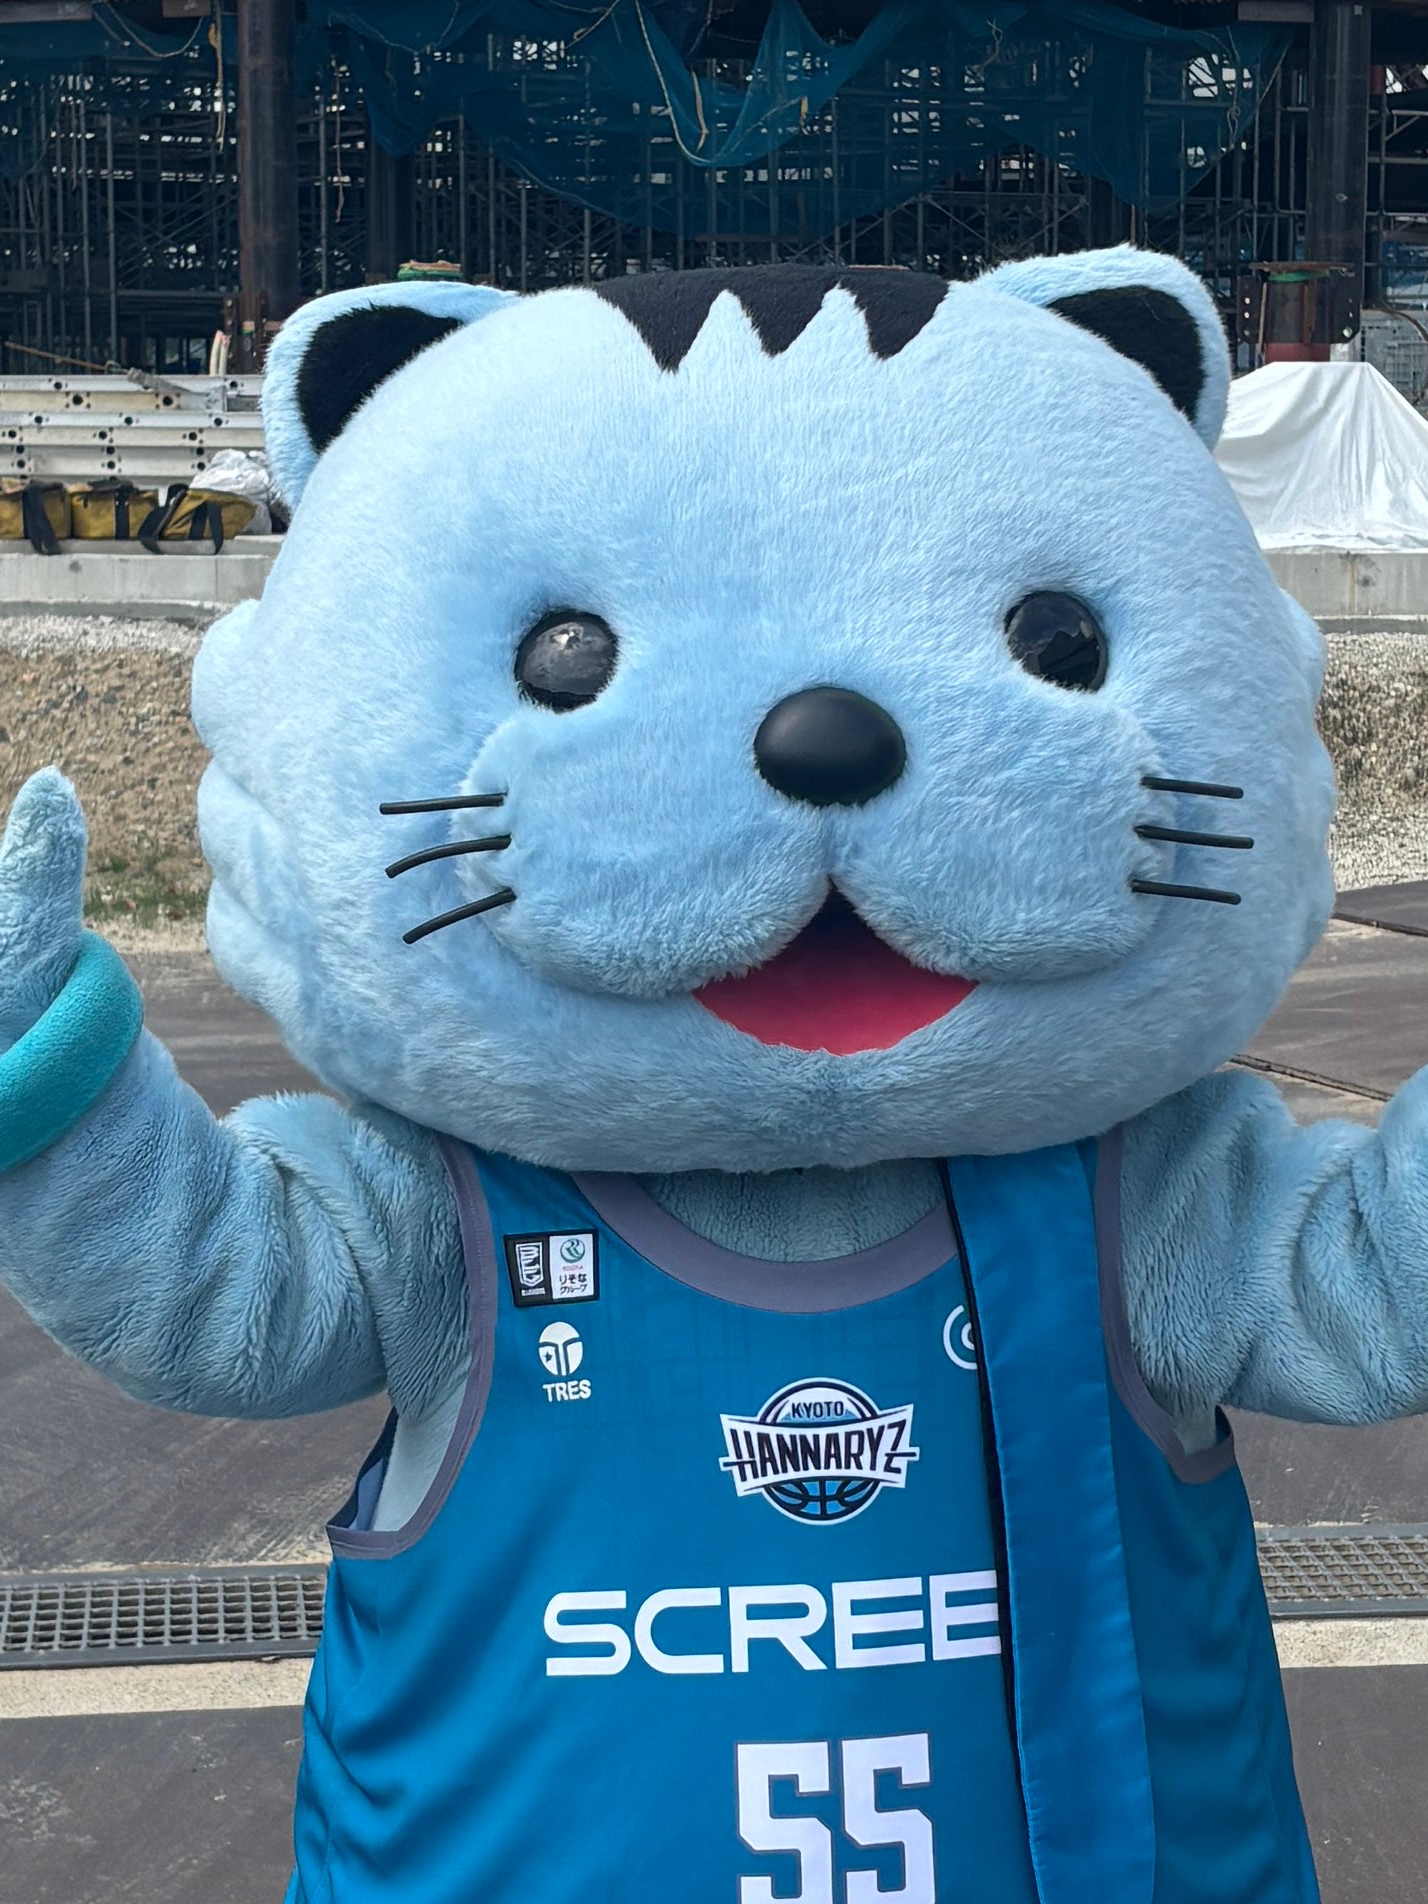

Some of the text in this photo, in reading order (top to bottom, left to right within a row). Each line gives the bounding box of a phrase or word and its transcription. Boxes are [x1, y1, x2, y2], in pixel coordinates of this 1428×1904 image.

[542, 1379, 592, 1403] TRES
[791, 1401, 844, 1418] KYOTO
[723, 1419, 916, 1482] HANNARYZ
